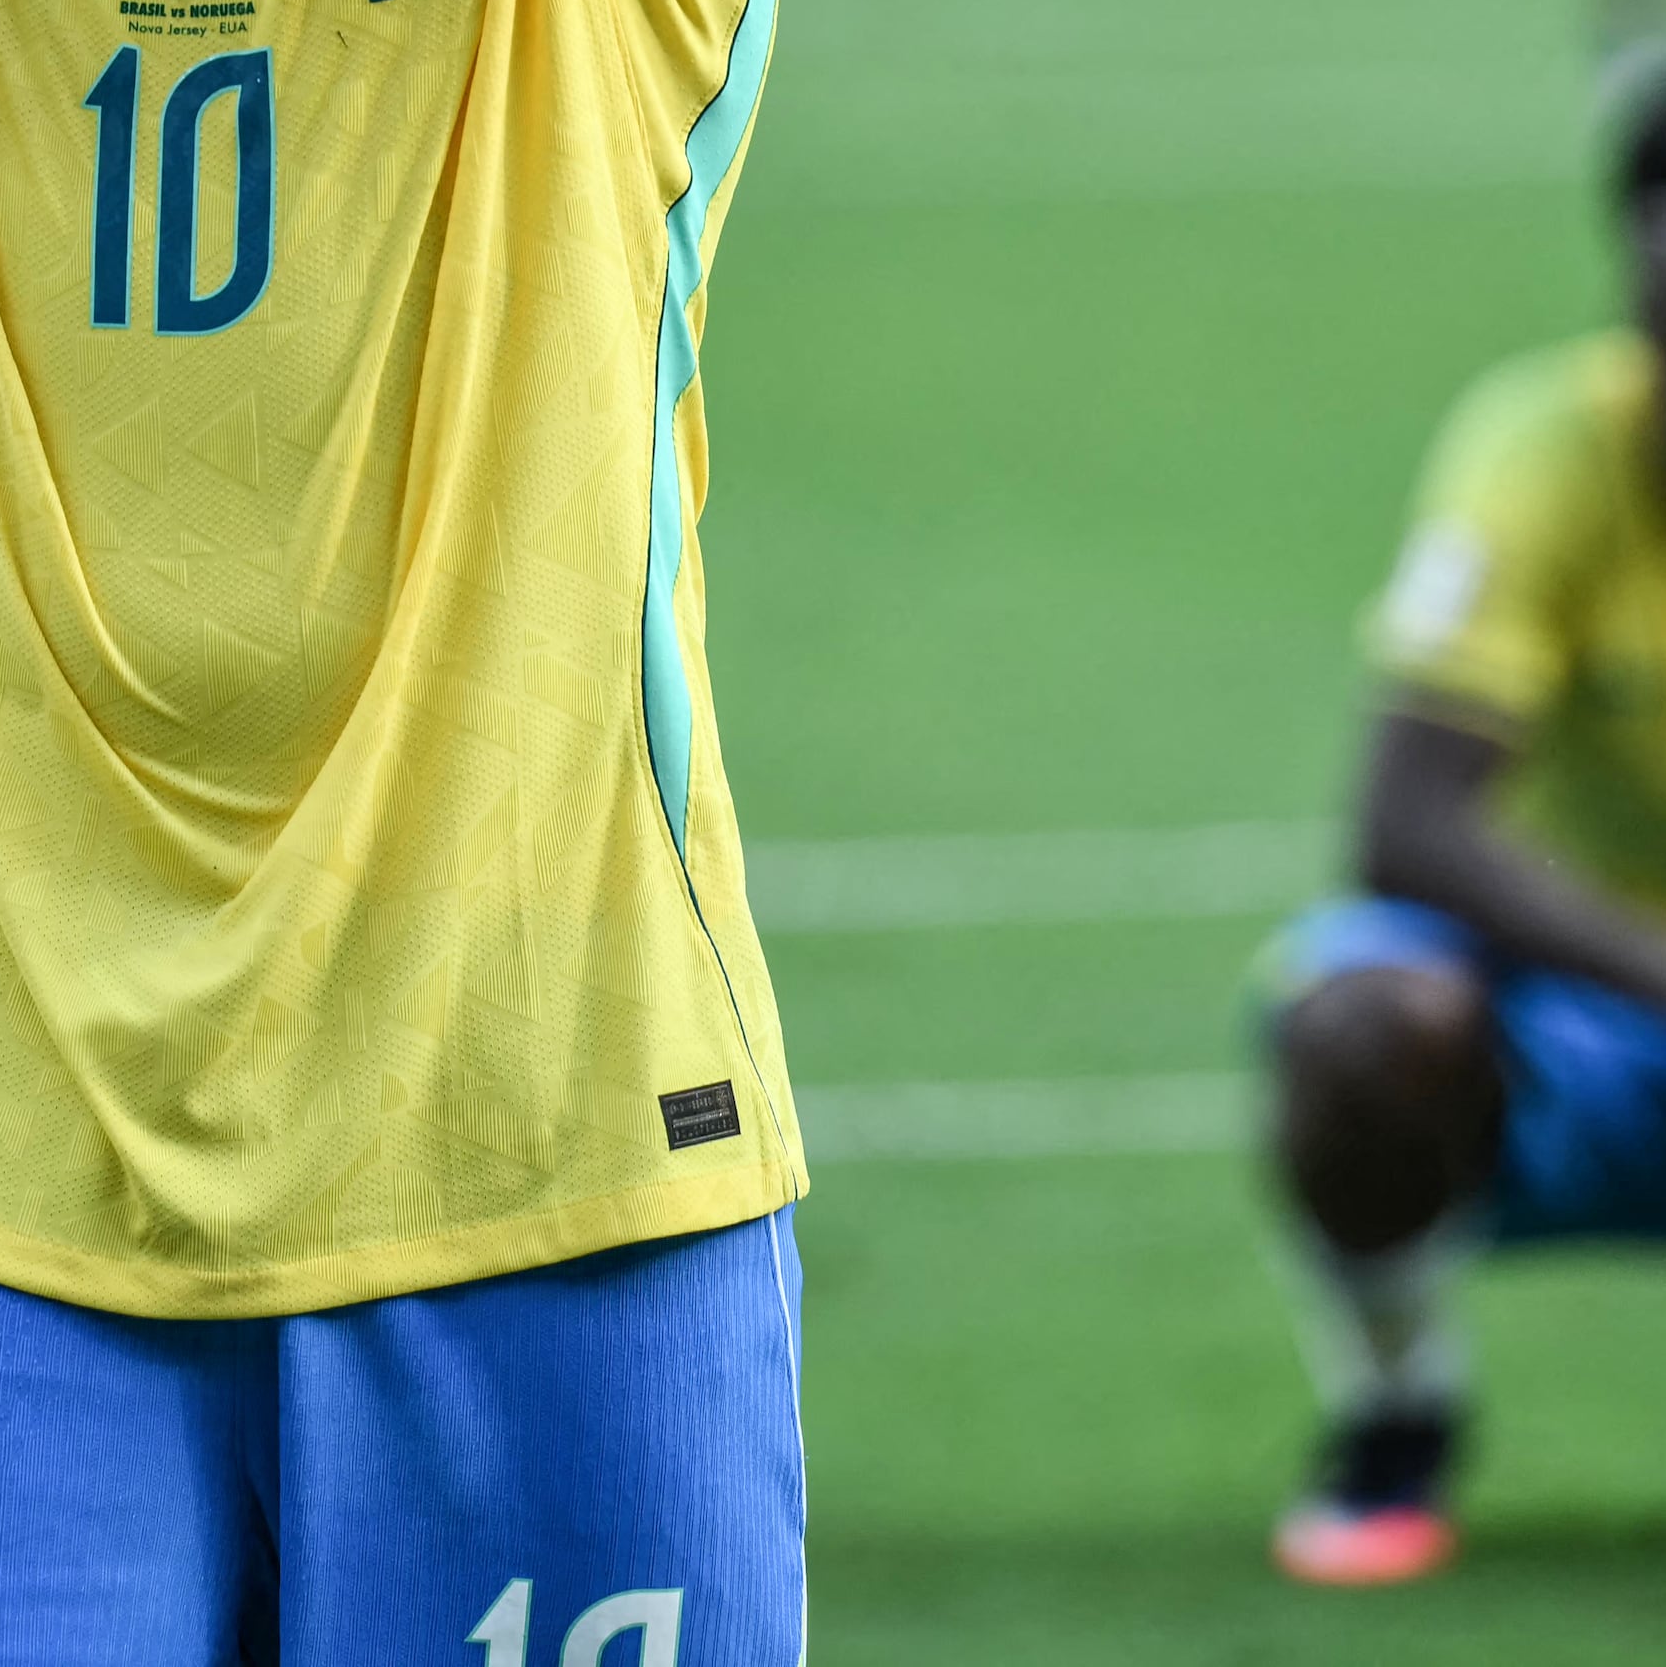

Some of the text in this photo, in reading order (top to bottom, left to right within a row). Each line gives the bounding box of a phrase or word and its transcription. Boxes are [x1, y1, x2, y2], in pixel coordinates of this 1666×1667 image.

[120, 0, 255, 18] BRASIL vs NORUEGA
[129, 21, 163, 35] Nova
[167, 23, 207, 38] Jersey
[219, 21, 247, 35] EUA
[82, 42, 276, 337] 10
